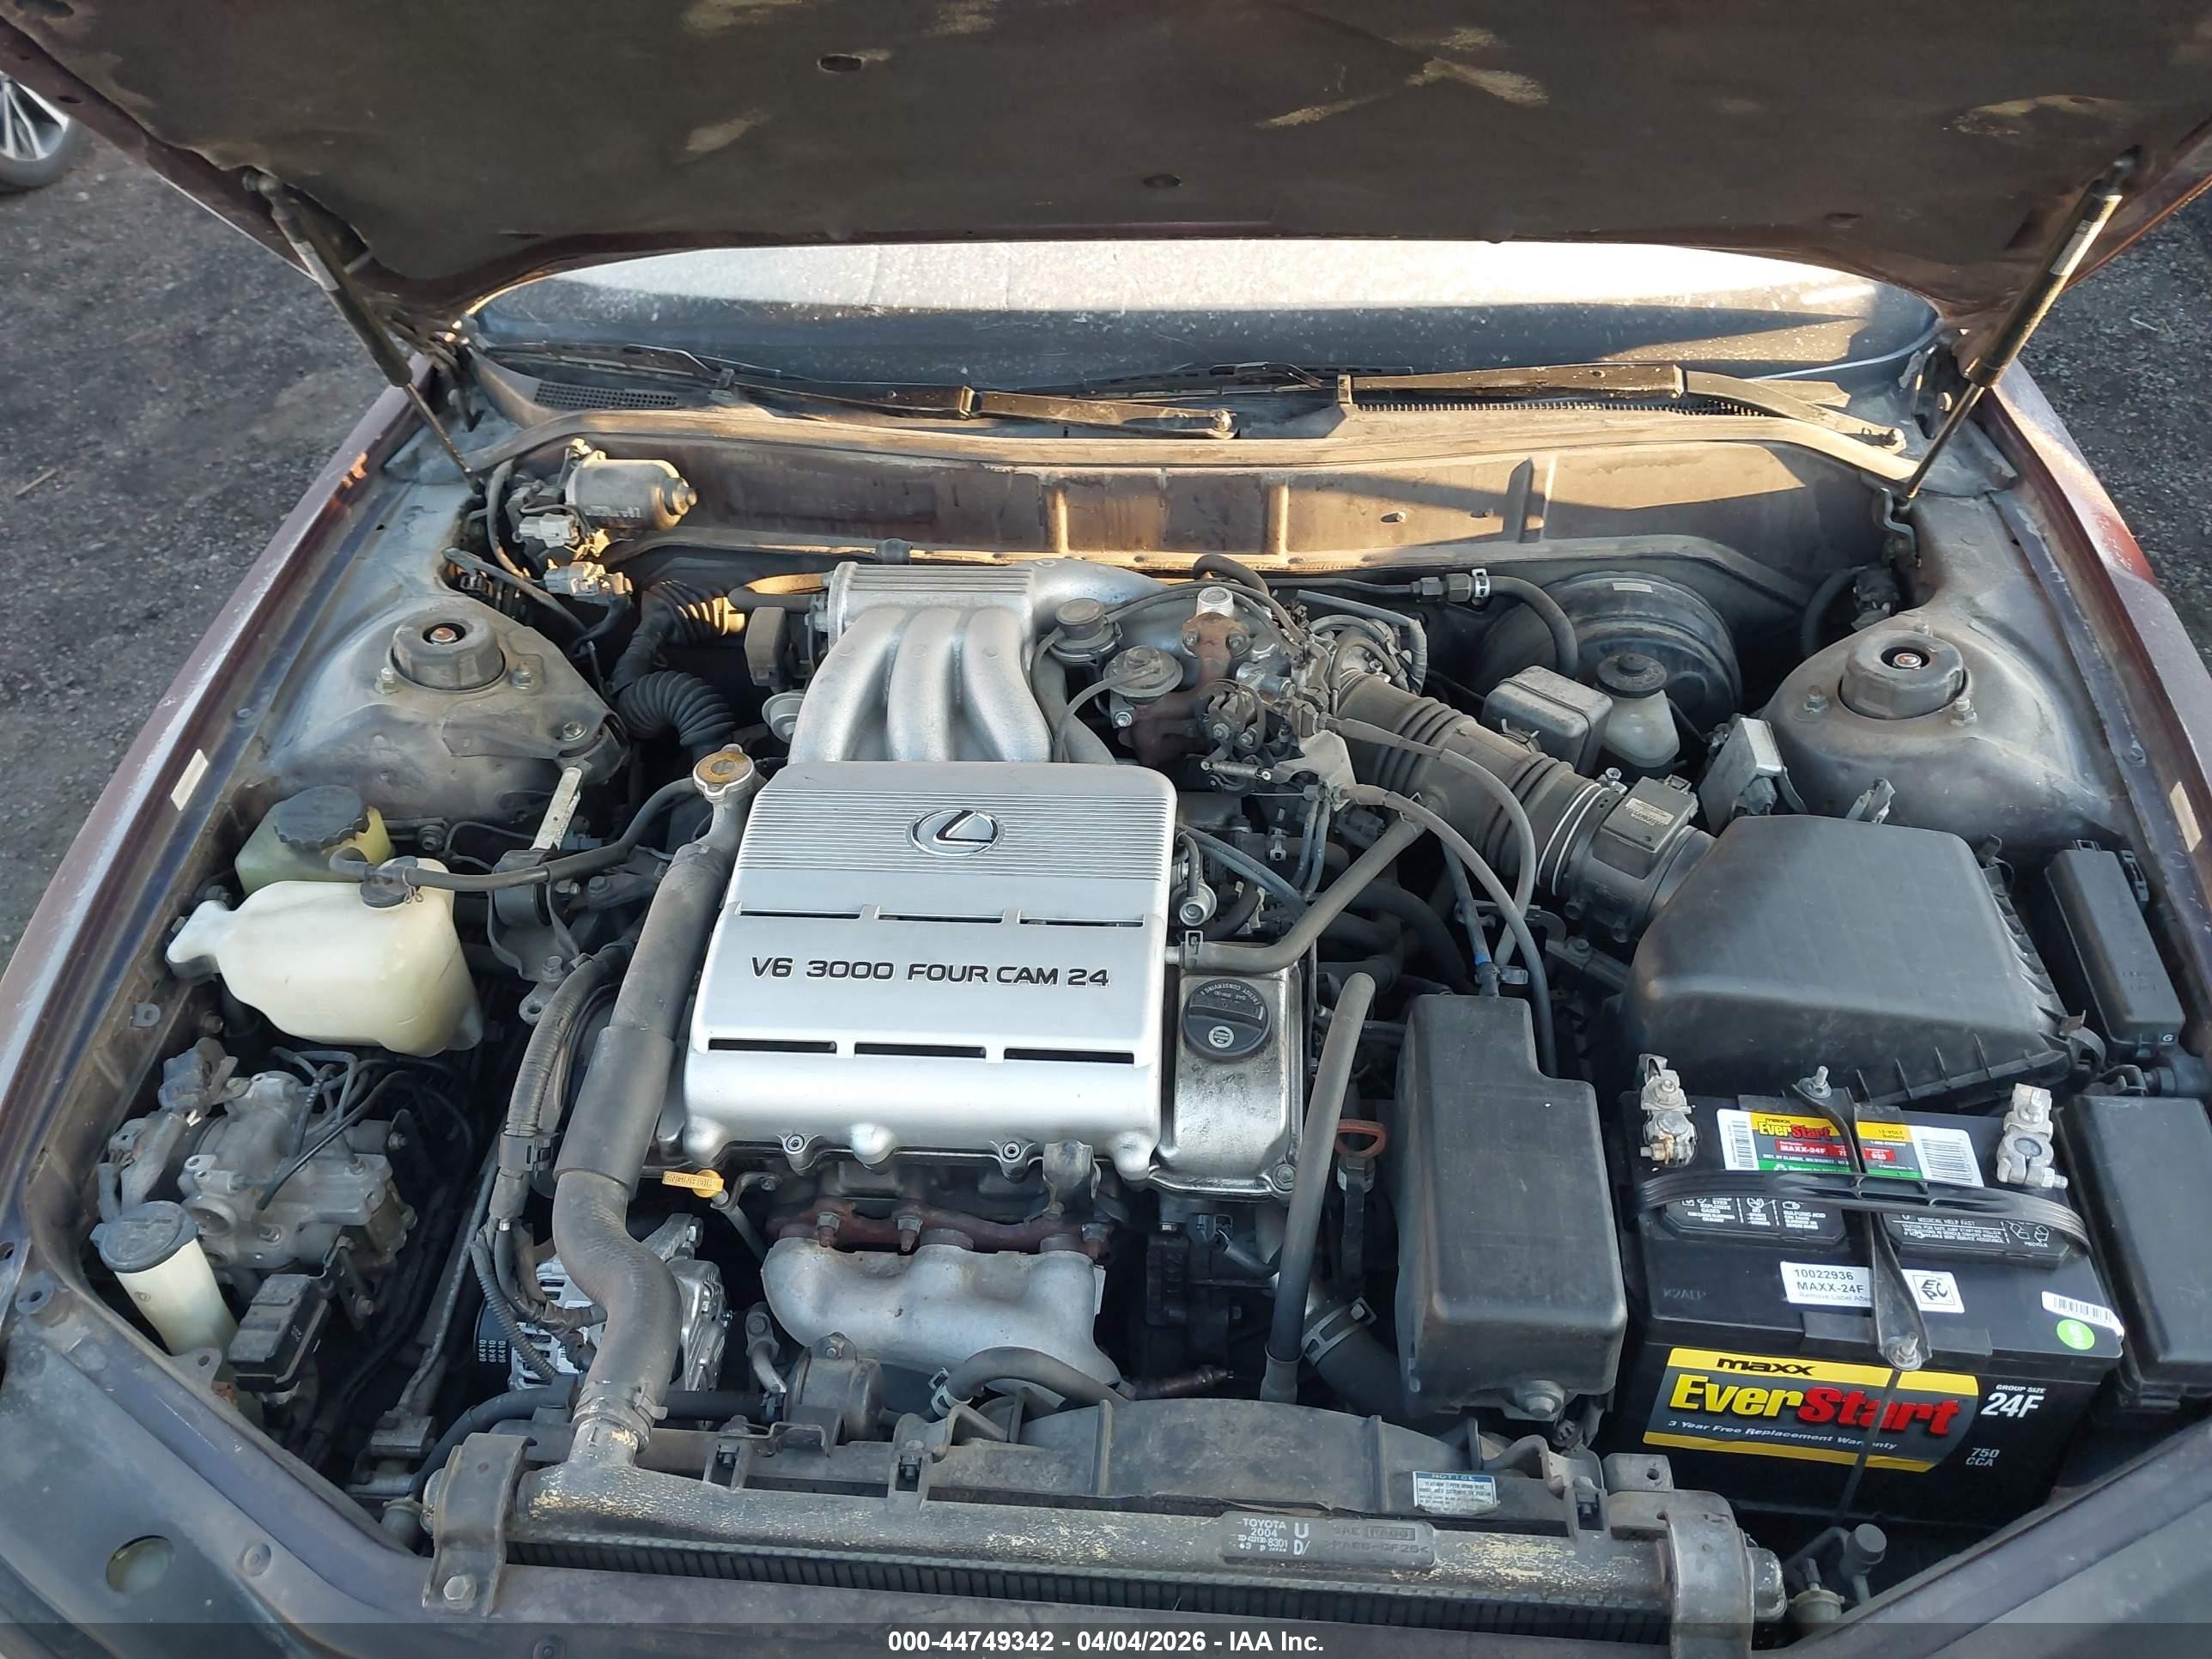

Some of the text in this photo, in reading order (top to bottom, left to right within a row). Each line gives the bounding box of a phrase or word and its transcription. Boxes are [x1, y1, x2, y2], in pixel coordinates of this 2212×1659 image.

[751, 957, 1109, 988] V6 3000 FOUR CAM 24
[1758, 1121, 1832, 1140] EverStart
[1779, 1144, 1826, 1155] MAXX-24F
[1917, 1216, 1943, 1224] MEDICAL
[1795, 1268, 1854, 1280] 10022936
[1796, 1280, 1864, 1293] MAXX-24F
[1717, 1358, 1816, 1376] maxx
[1995, 1383, 2027, 1392] GROUP
[1668, 1373, 1961, 1437] EverStart
[1980, 1392, 2045, 1419] 24F
[1680, 1420, 1711, 1431] Year
[1713, 1424, 1741, 1435] Free
[1745, 1427, 1834, 1443] Replacement
[1837, 1437, 1898, 1451] Warnty
[1971, 1447, 2000, 1458] 750
[1965, 1456, 1994, 1467] CCA
[1431, 1473, 1475, 1481] NOTICE
[1243, 1517, 1286, 1530] TOYOTA
[1250, 1528, 1279, 1539] 2004
[1294, 1522, 1310, 1539] U
